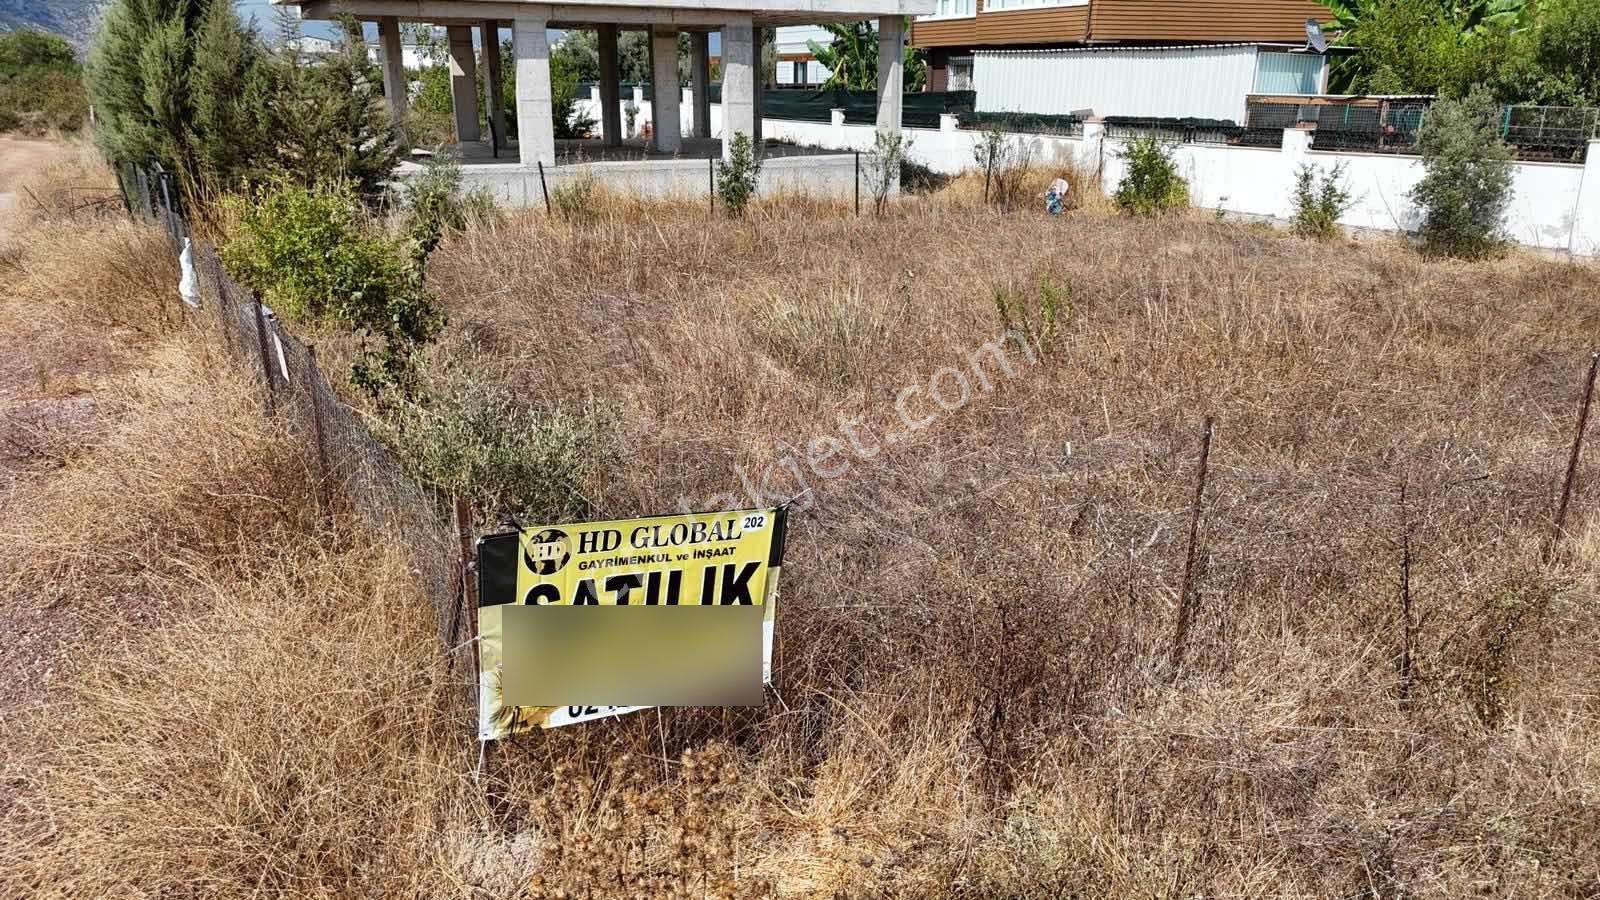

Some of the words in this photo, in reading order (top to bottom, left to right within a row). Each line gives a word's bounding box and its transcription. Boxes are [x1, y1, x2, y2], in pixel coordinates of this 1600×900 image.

[743, 516, 764, 529] 202
[577, 529, 622, 554] HD
[630, 519, 742, 549] GLOBAL
[578, 553, 673, 571] GAYRİMENKUL
[676, 552, 689, 561] ve
[693, 546, 737, 560] İNŞAAT
